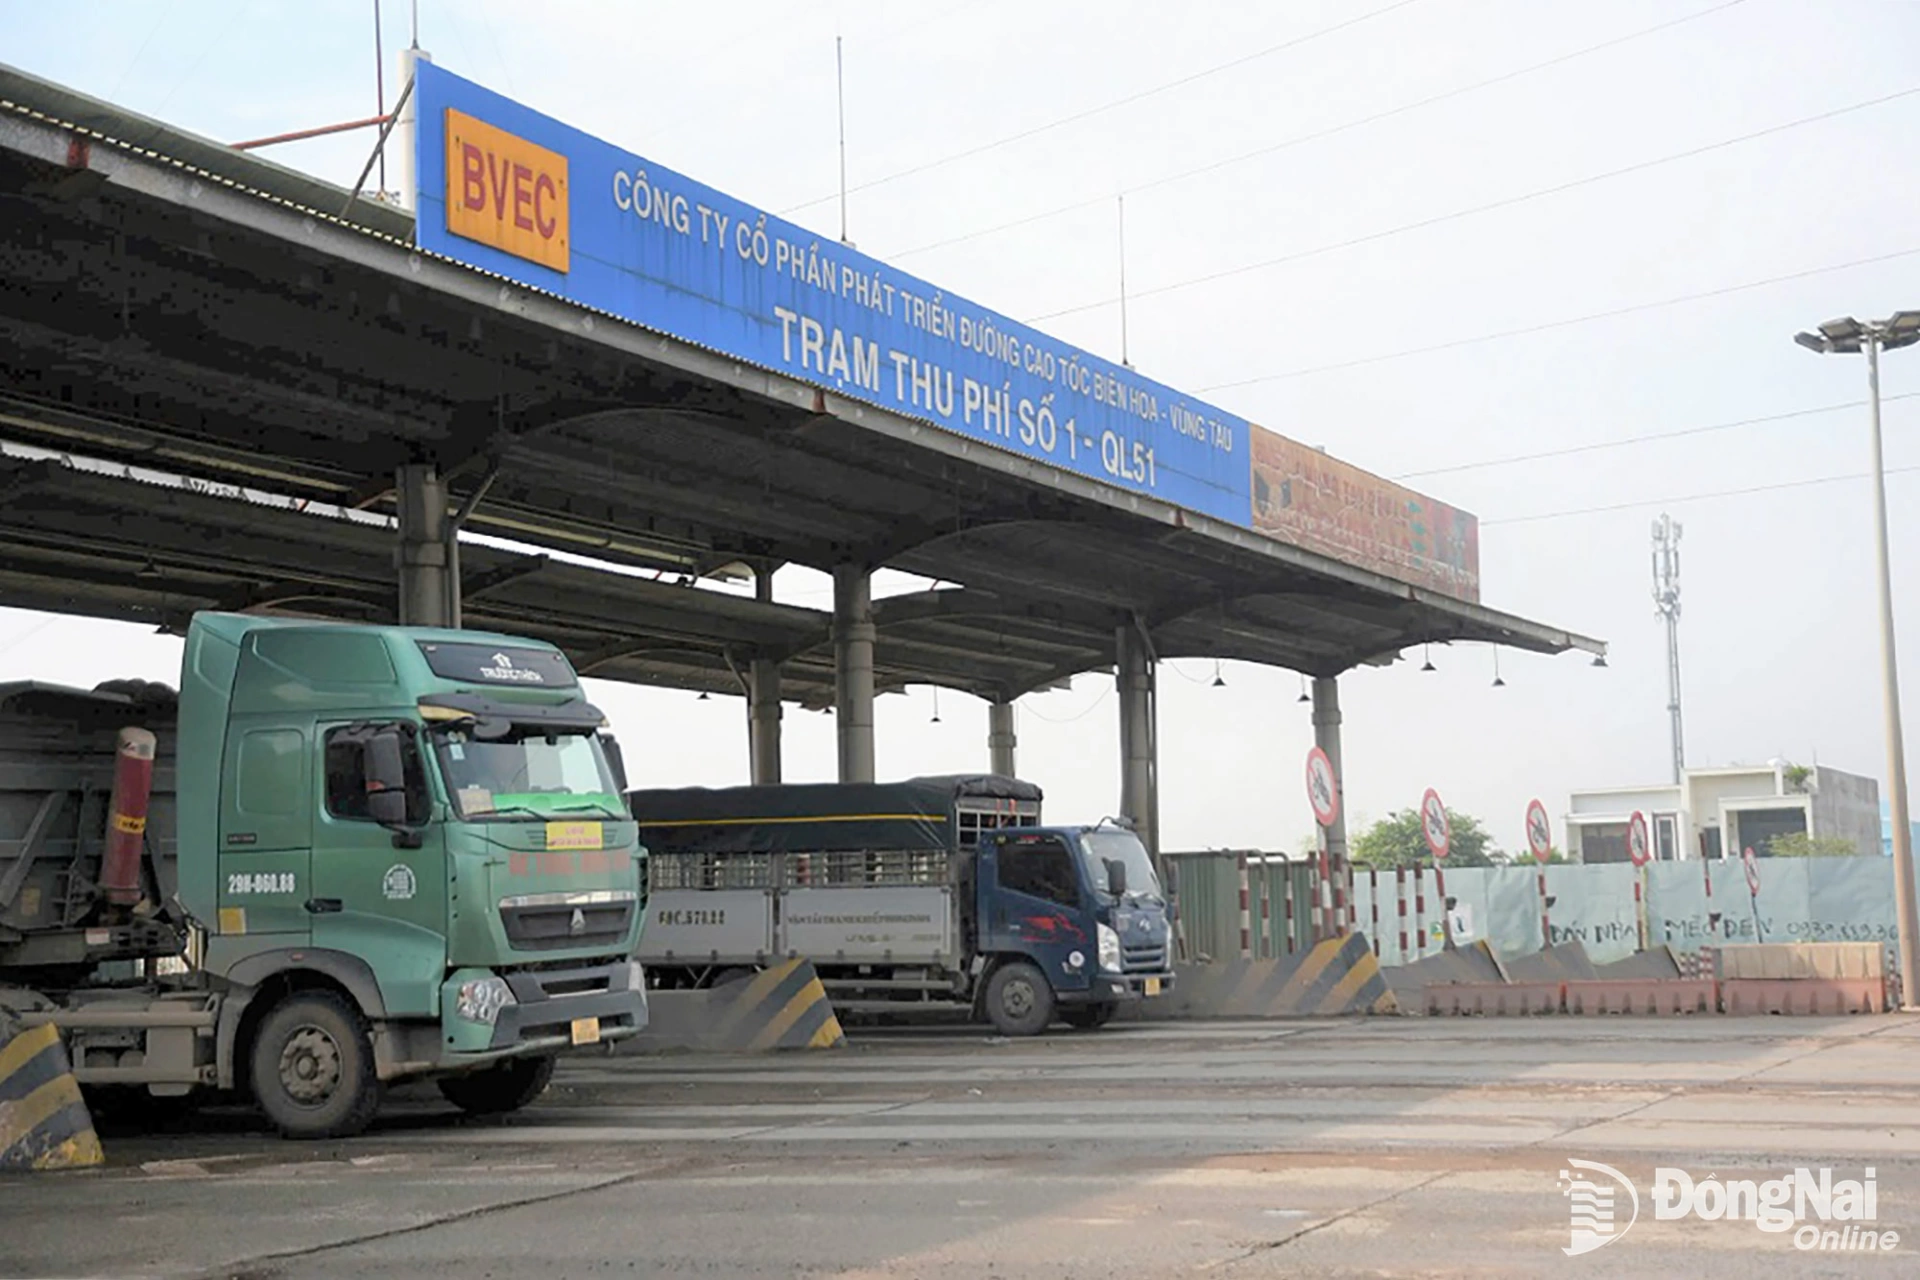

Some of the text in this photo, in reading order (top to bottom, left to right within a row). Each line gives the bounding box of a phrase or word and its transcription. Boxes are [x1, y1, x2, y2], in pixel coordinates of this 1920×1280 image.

[462, 142, 556, 240] BVEC
[613, 169, 690, 235] CÔNG
[697, 204, 728, 249] TY
[736, 213, 769, 266] CỔ
[842, 271, 896, 316] PHÁT
[901, 290, 956, 342] TRIỂN
[1024, 343, 1056, 382] CAO
[1058, 354, 1091, 396] TỐC
[1094, 371, 1127, 411] BIÊN
[774, 305, 880, 393] TRẠM
[888, 350, 954, 418] THU
[963, 381, 1010, 438] PHÍ
[1018, 393, 1057, 453] SỐ
[1065, 418, 1076, 460] 1
[1101, 429, 1156, 487] QL51
